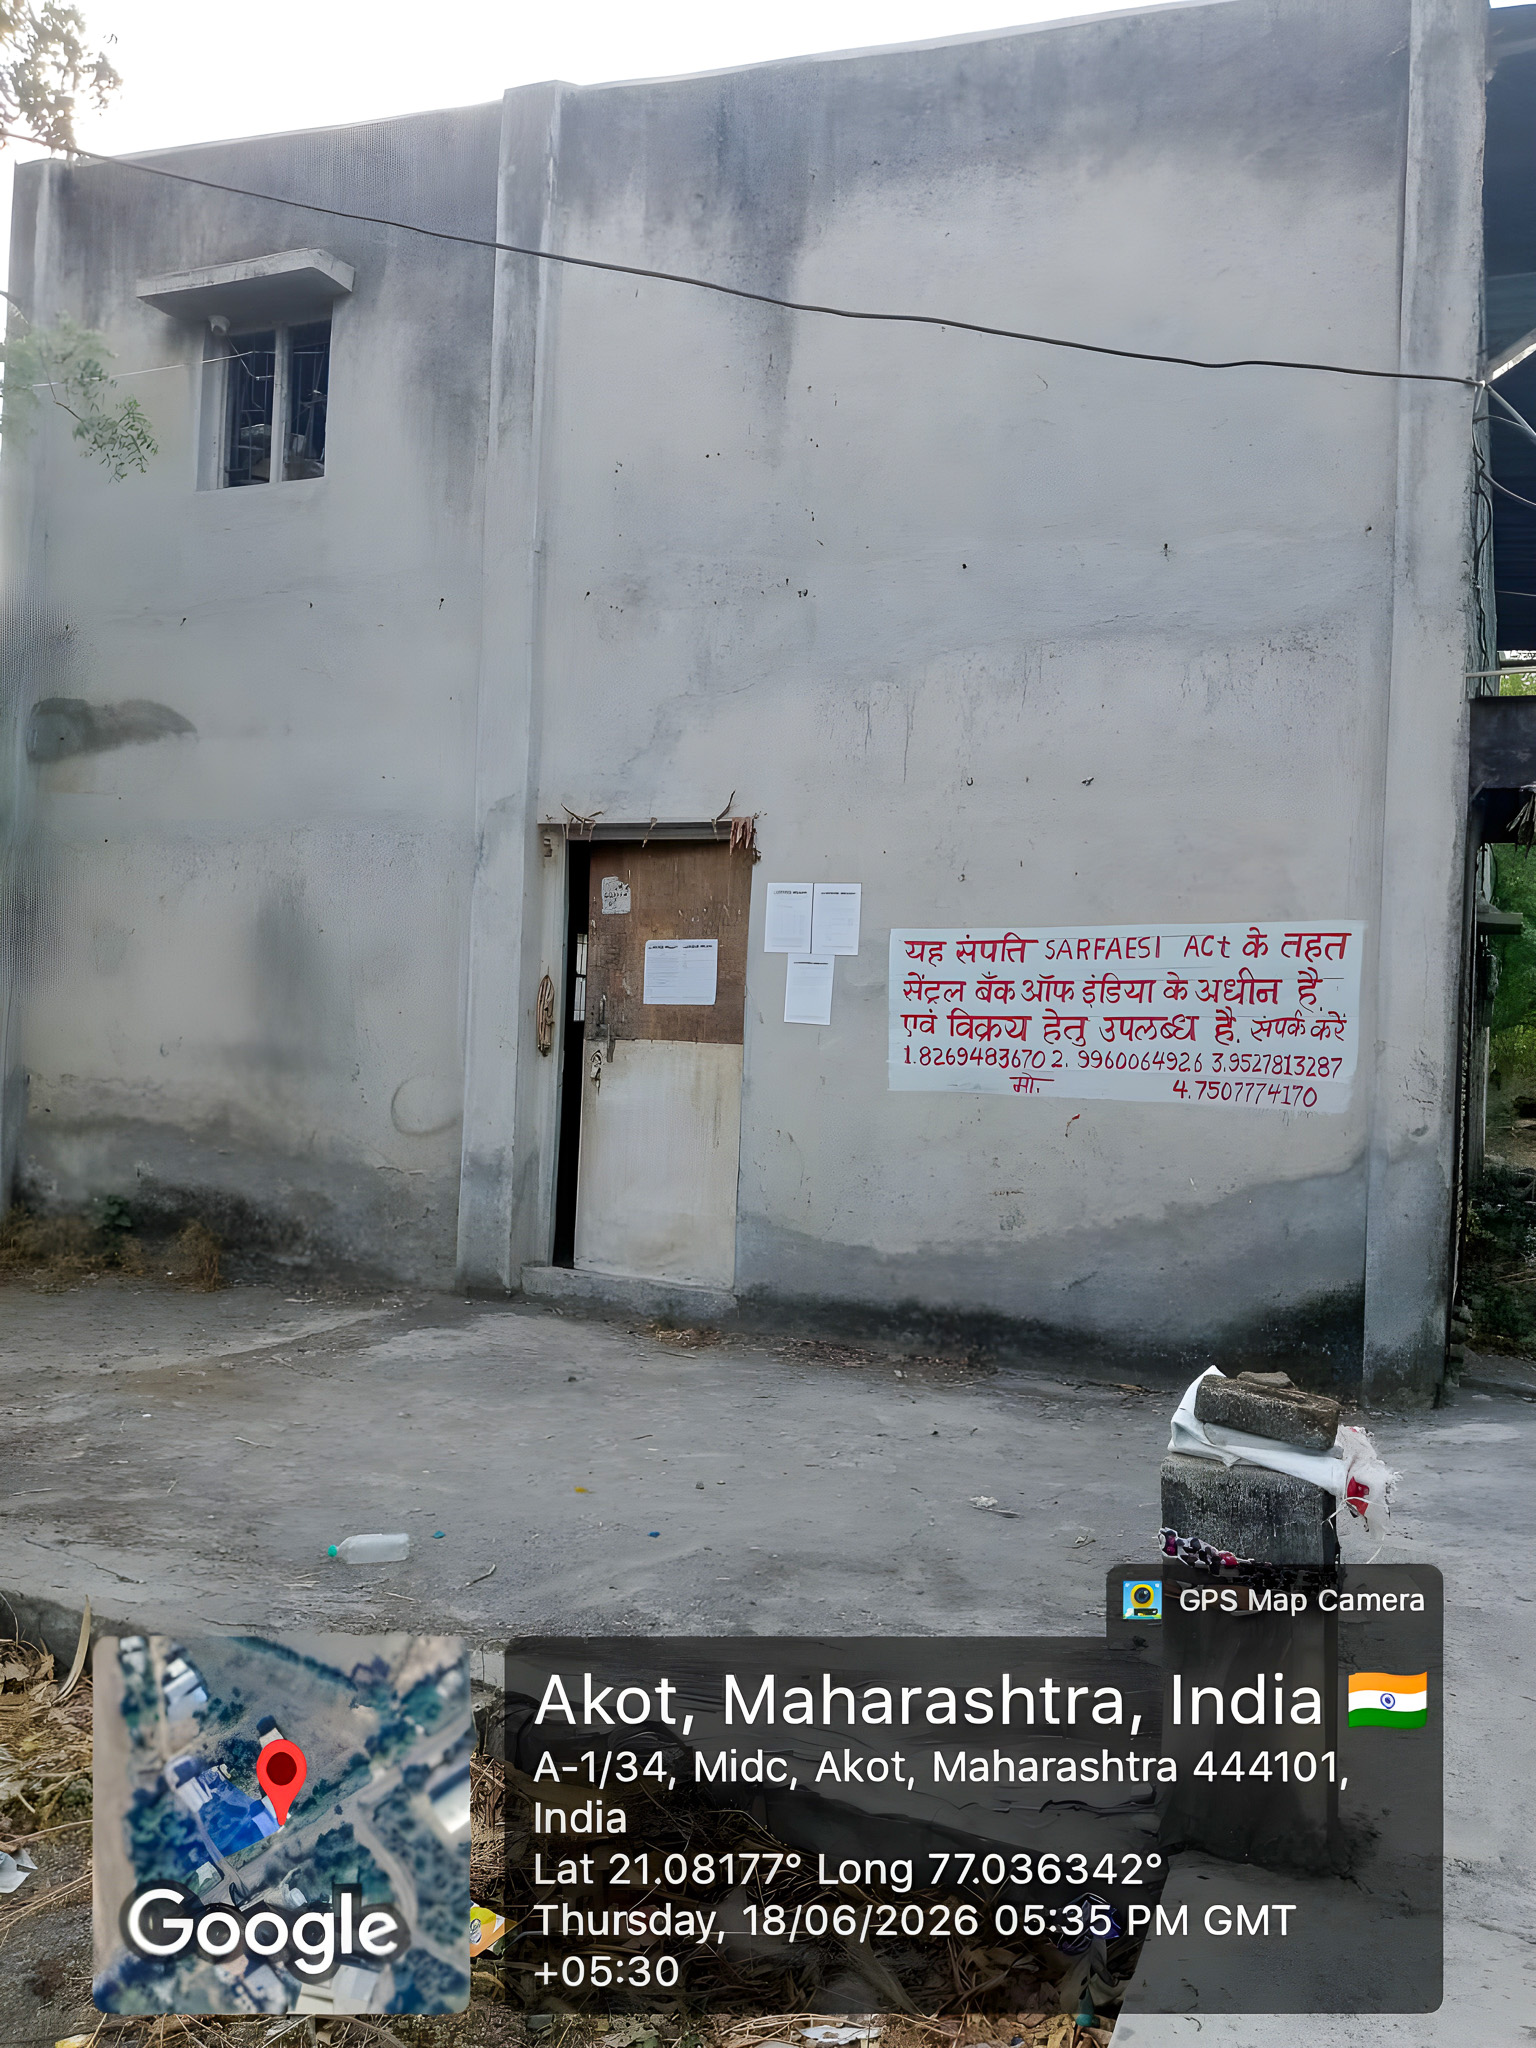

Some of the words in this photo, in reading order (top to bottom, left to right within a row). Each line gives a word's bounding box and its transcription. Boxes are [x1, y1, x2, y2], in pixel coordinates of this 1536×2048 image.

[903, 939, 948, 967] यह
[1045, 935, 1161, 961] SARFAESI
[1242, 926, 1269, 959] के
[1280, 931, 1353, 963] तहत
[1020, 972, 1075, 1004] ऑफ
[1081, 971, 1157, 1009] इंडिया
[1162, 971, 1189, 1001] के
[1194, 966, 1283, 1006] अधीन
[899, 1007, 938, 1038] एवं
[945, 1006, 1033, 1042] विक्रय
[1041, 1007, 1090, 1047] हेतु
[1098, 1012, 1200, 1042] उपलब्ध
[1250, 1008, 1306, 1042] संपर्क
[1310, 1010, 1348, 1042] करें
